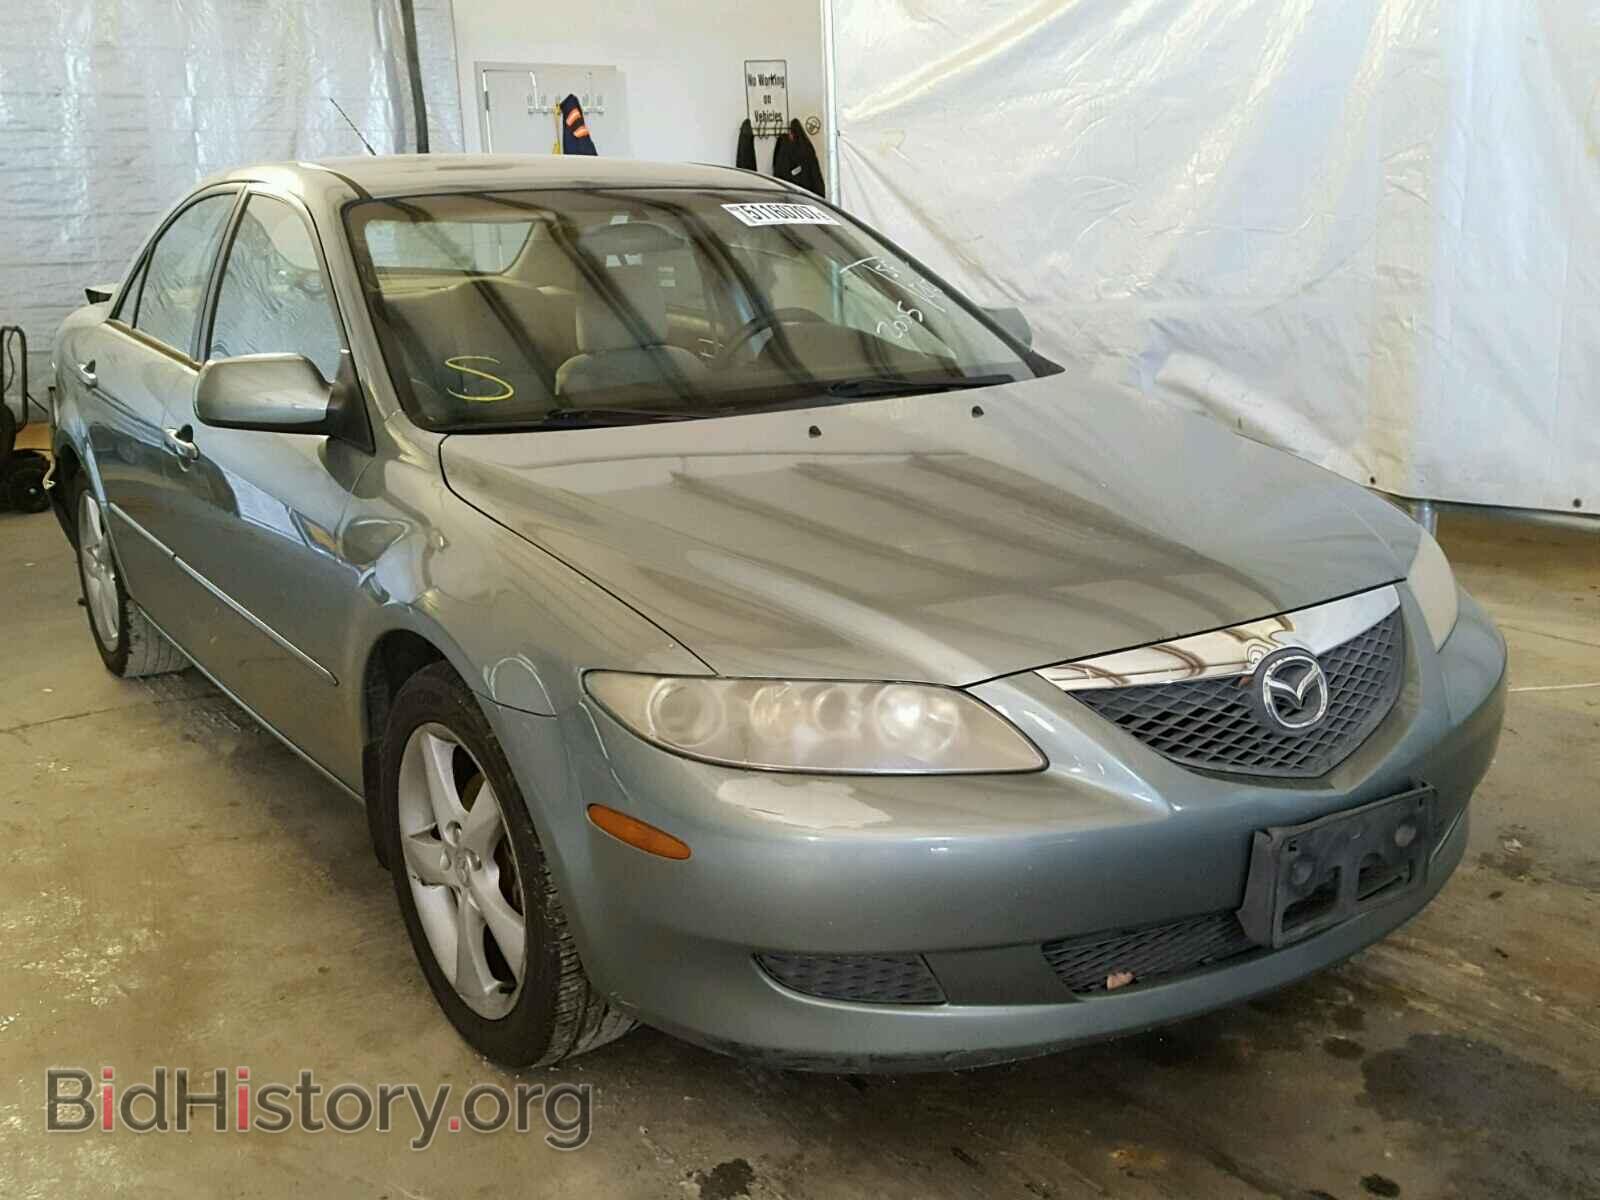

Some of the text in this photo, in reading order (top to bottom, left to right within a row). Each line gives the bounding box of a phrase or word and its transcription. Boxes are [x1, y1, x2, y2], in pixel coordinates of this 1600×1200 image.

[747, 72, 785, 88] No Working
[763, 94, 772, 105] on
[754, 110, 783, 123] Vehicles
